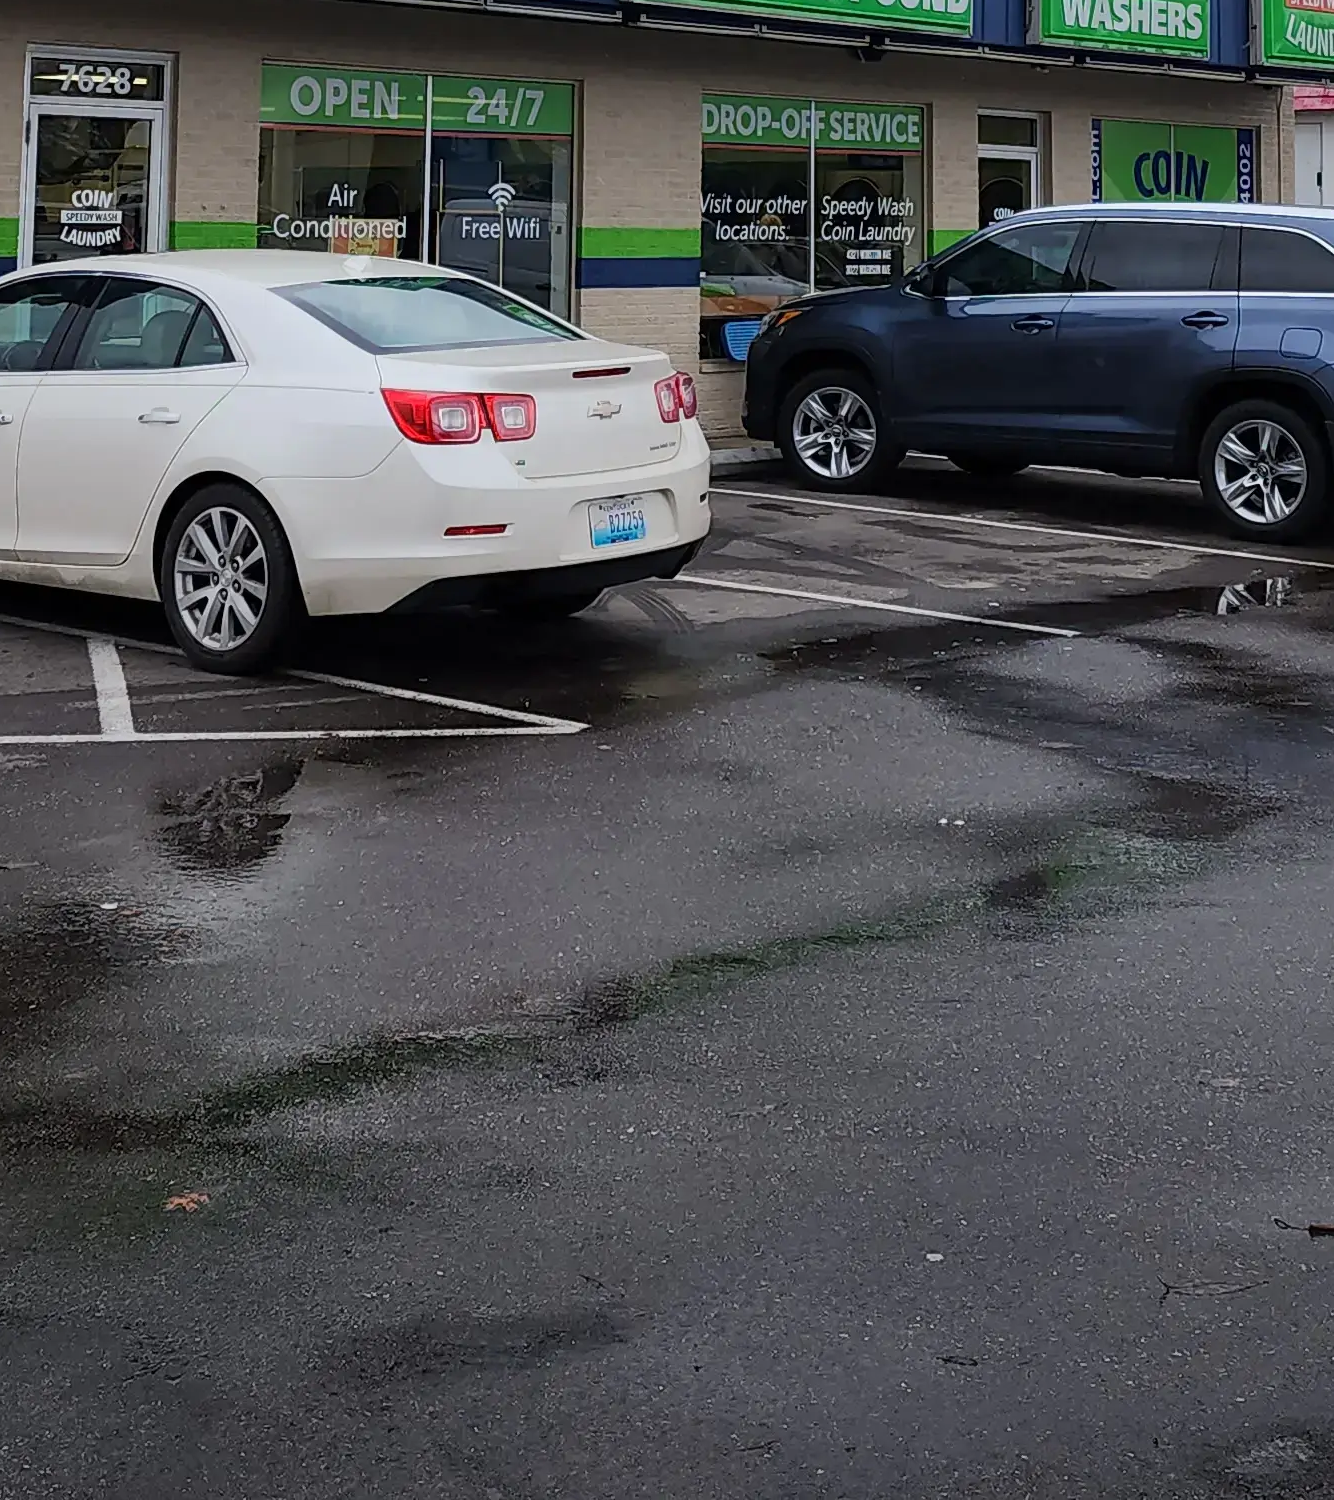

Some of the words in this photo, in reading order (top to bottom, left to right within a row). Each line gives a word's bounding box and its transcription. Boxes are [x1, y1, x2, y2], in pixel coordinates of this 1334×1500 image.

[59, 63, 131, 95] 7628
[290, 75, 399, 120] OPEN
[467, 86, 544, 127] 24/7
[701, 102, 825, 140] DROP-OFF
[829, 110, 921, 144] SERVICE
[1133, 150, 1210, 201] COIN
[71, 189, 115, 209] COIN
[327, 183, 358, 208] Air
[700, 192, 733, 214] Visit
[735, 200, 764, 214] our
[766, 195, 808, 215] other
[820, 195, 873, 220] Speedy
[877, 197, 914, 216] Wash
[65, 212, 94, 223] SPEEDY
[95, 213, 118, 223] WASH
[273, 213, 407, 239] Conditioned
[461, 216, 501, 239] Free
[505, 216, 540, 239] Wifi
[60, 225, 122, 247] LAUNDRY
[820, 220, 855, 241] Coin
[859, 220, 916, 246] Laundry
